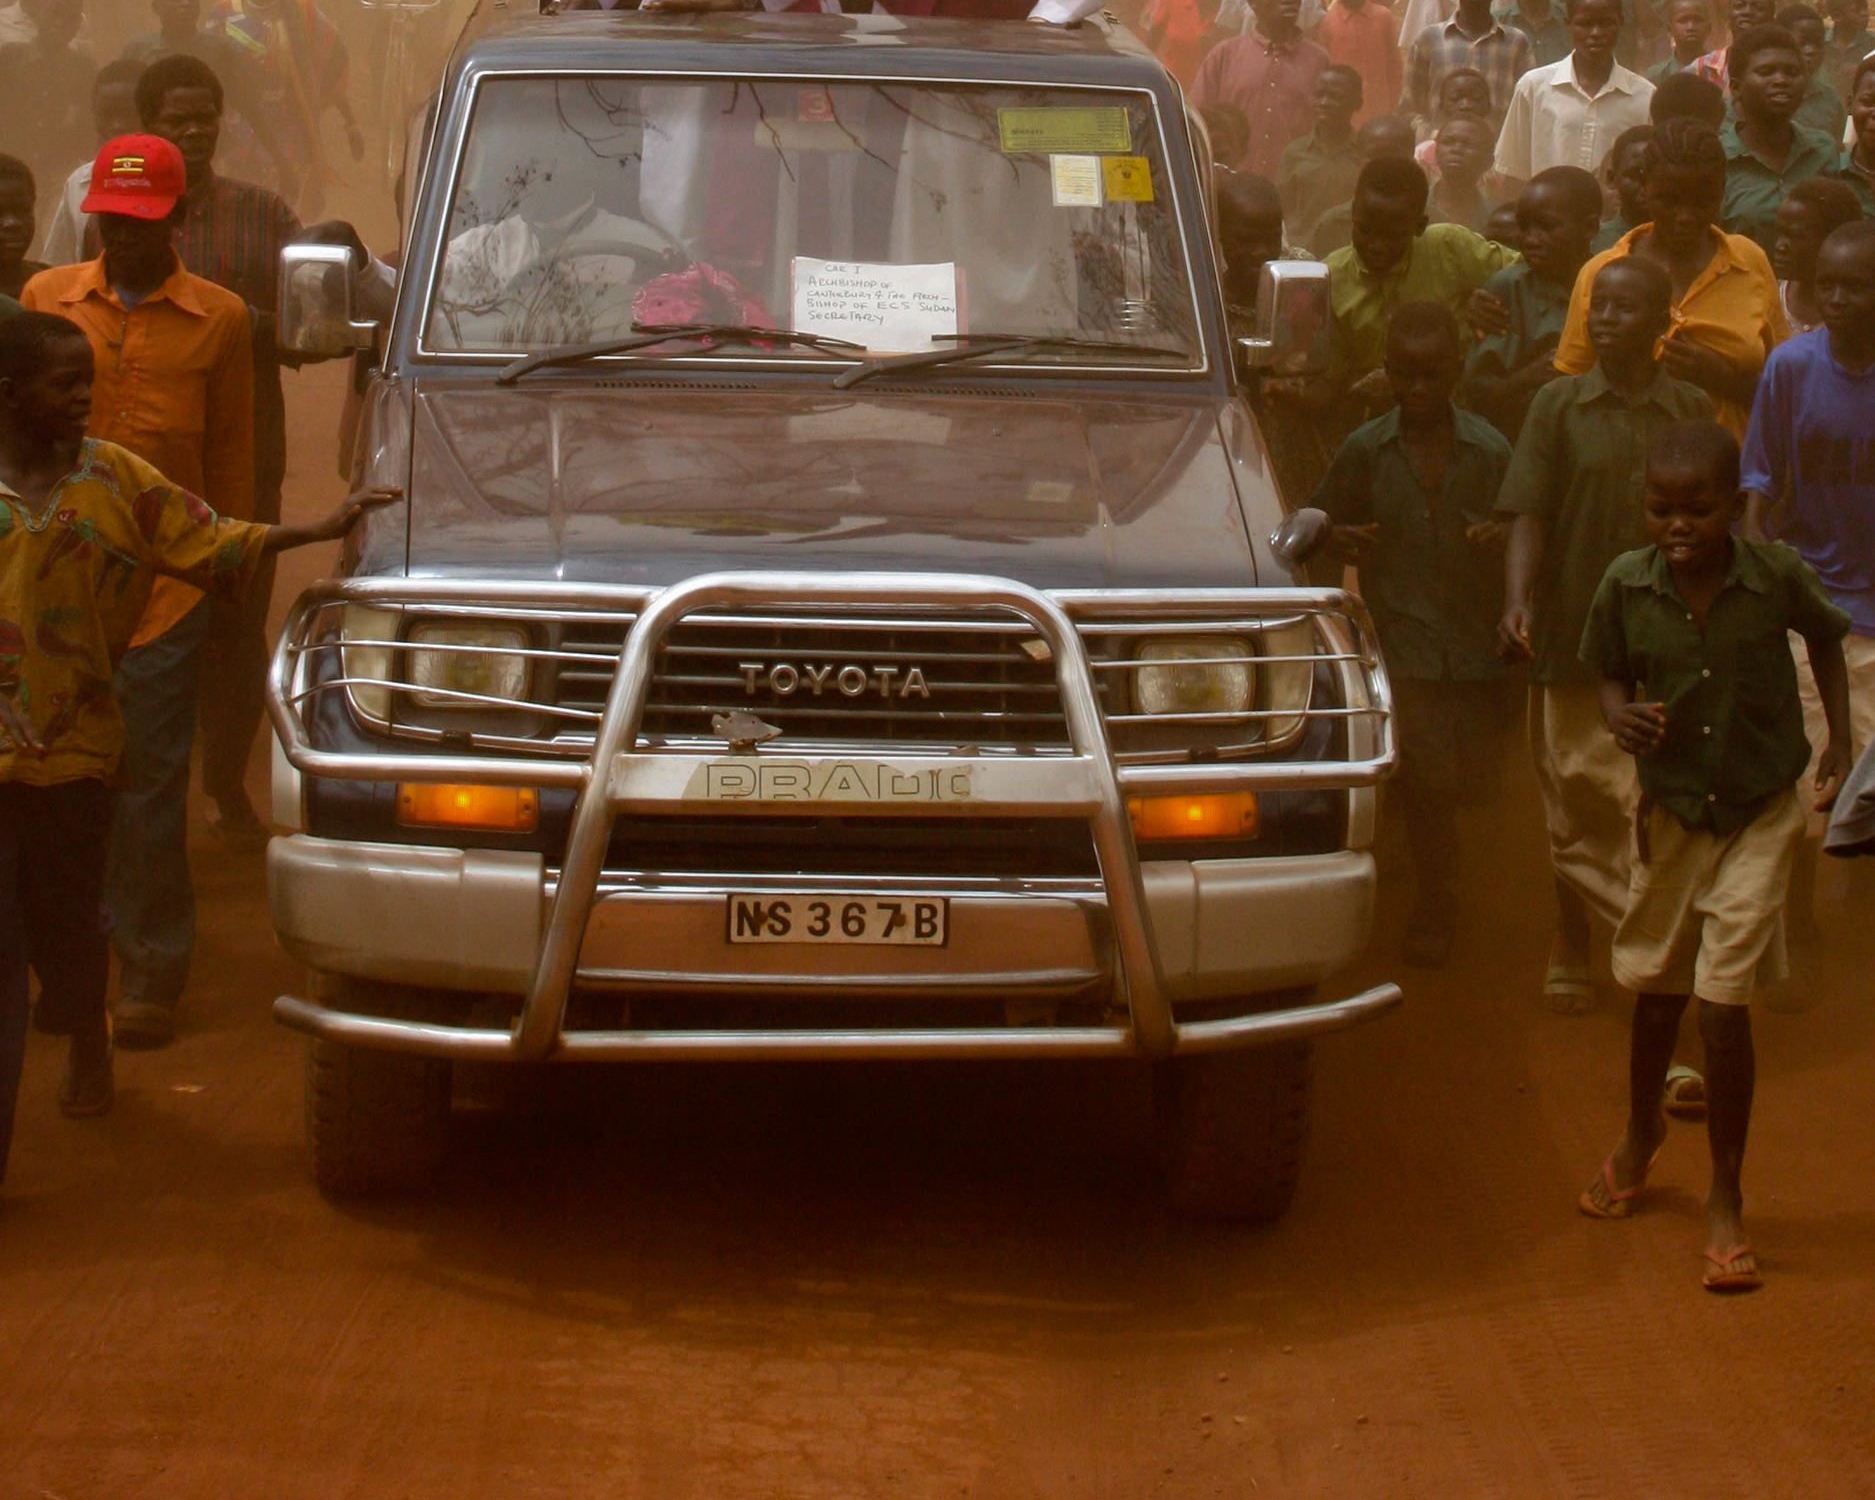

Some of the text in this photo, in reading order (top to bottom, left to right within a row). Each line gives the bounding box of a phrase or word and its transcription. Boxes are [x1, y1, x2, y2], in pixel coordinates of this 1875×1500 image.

[808, 275, 877, 288] ARCHBISHOP
[853, 302, 868, 310] OF
[739, 662, 930, 697] TOYOTA
